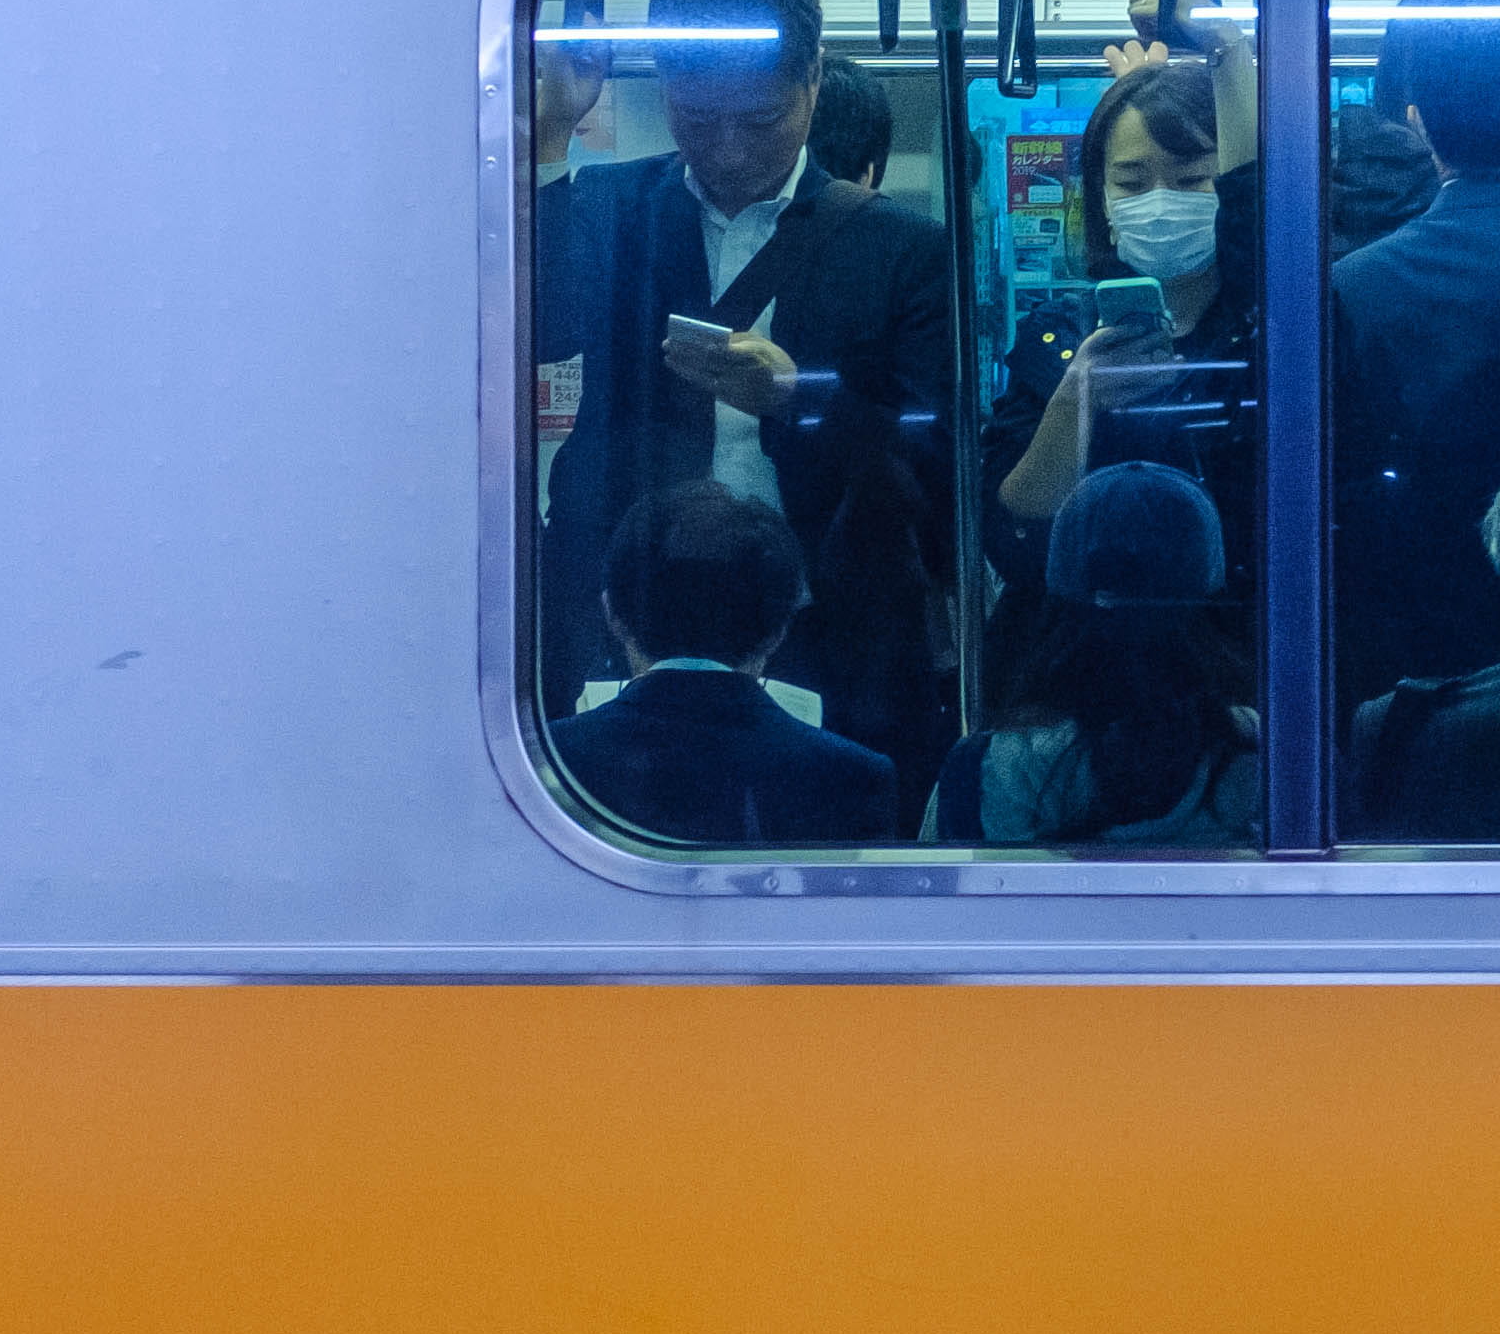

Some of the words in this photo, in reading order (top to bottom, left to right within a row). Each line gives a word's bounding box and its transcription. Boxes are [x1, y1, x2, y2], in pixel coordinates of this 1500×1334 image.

[1012, 154, 1064, 165] カレンダー
